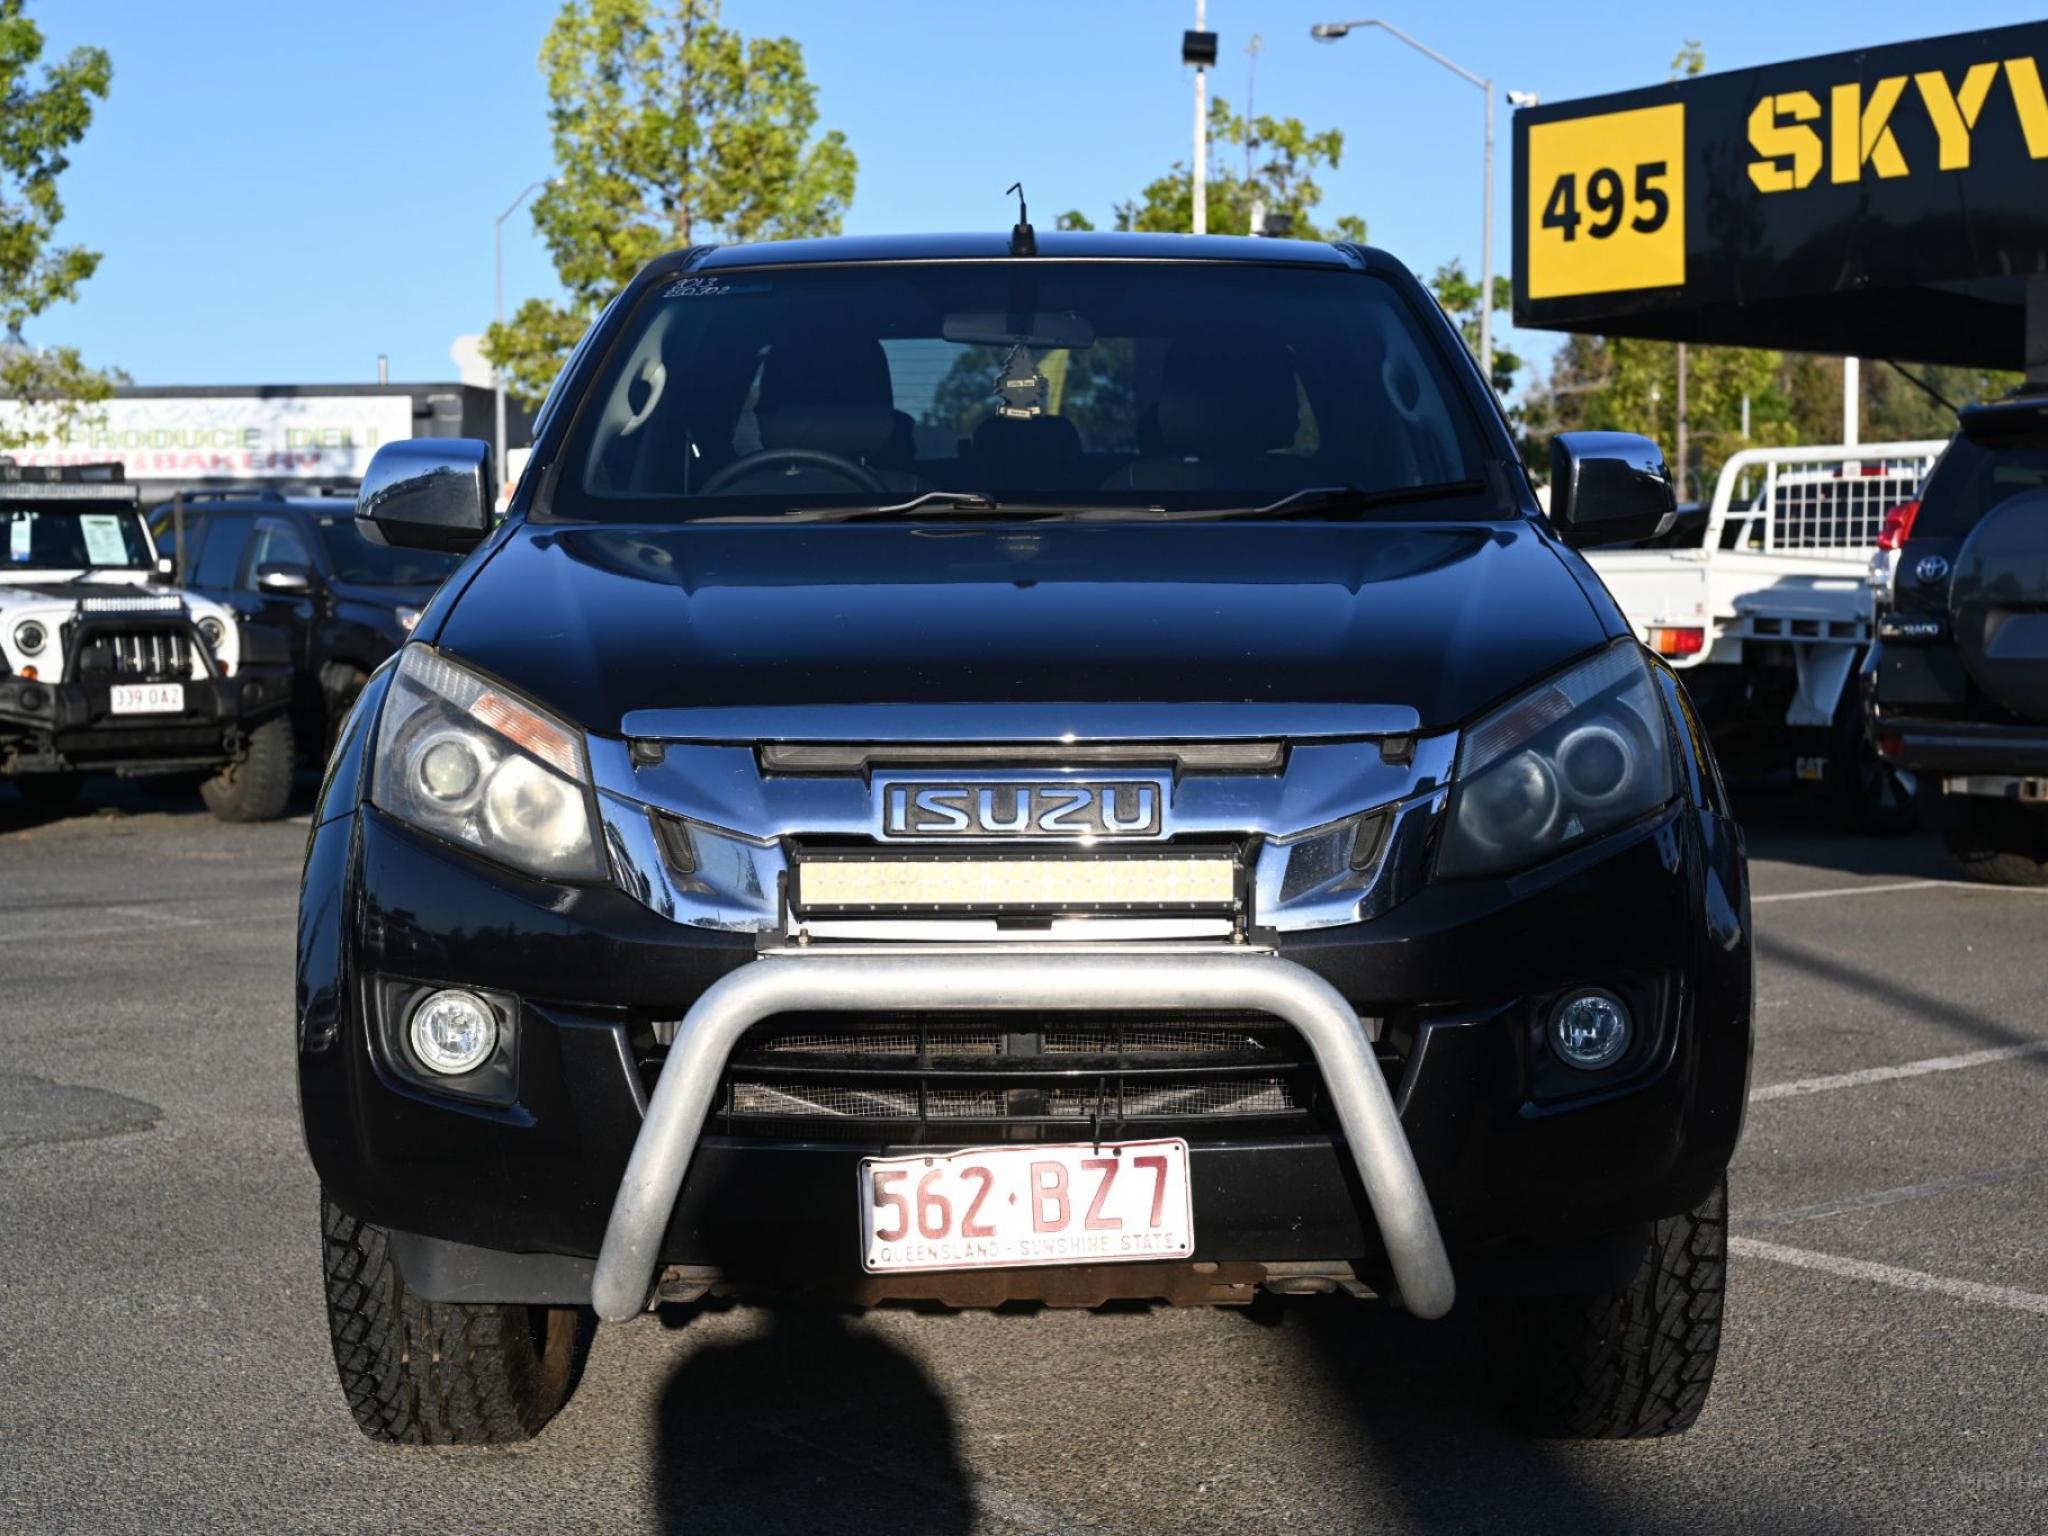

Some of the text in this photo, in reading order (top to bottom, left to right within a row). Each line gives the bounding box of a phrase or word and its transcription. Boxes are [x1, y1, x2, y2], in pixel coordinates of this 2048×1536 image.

[1541, 160, 1669, 242] 495
[61, 427, 378, 448] PRODUCE DELI
[152, 451, 319, 471] BAKERY
[1796, 756, 1830, 779] CAT
[890, 787, 1153, 831] ISUZU
[880, 1241, 999, 1263] QUEENSLAND
[1020, 1237, 1110, 1255] SUNSHINE
[1120, 1231, 1176, 1251] STATE
